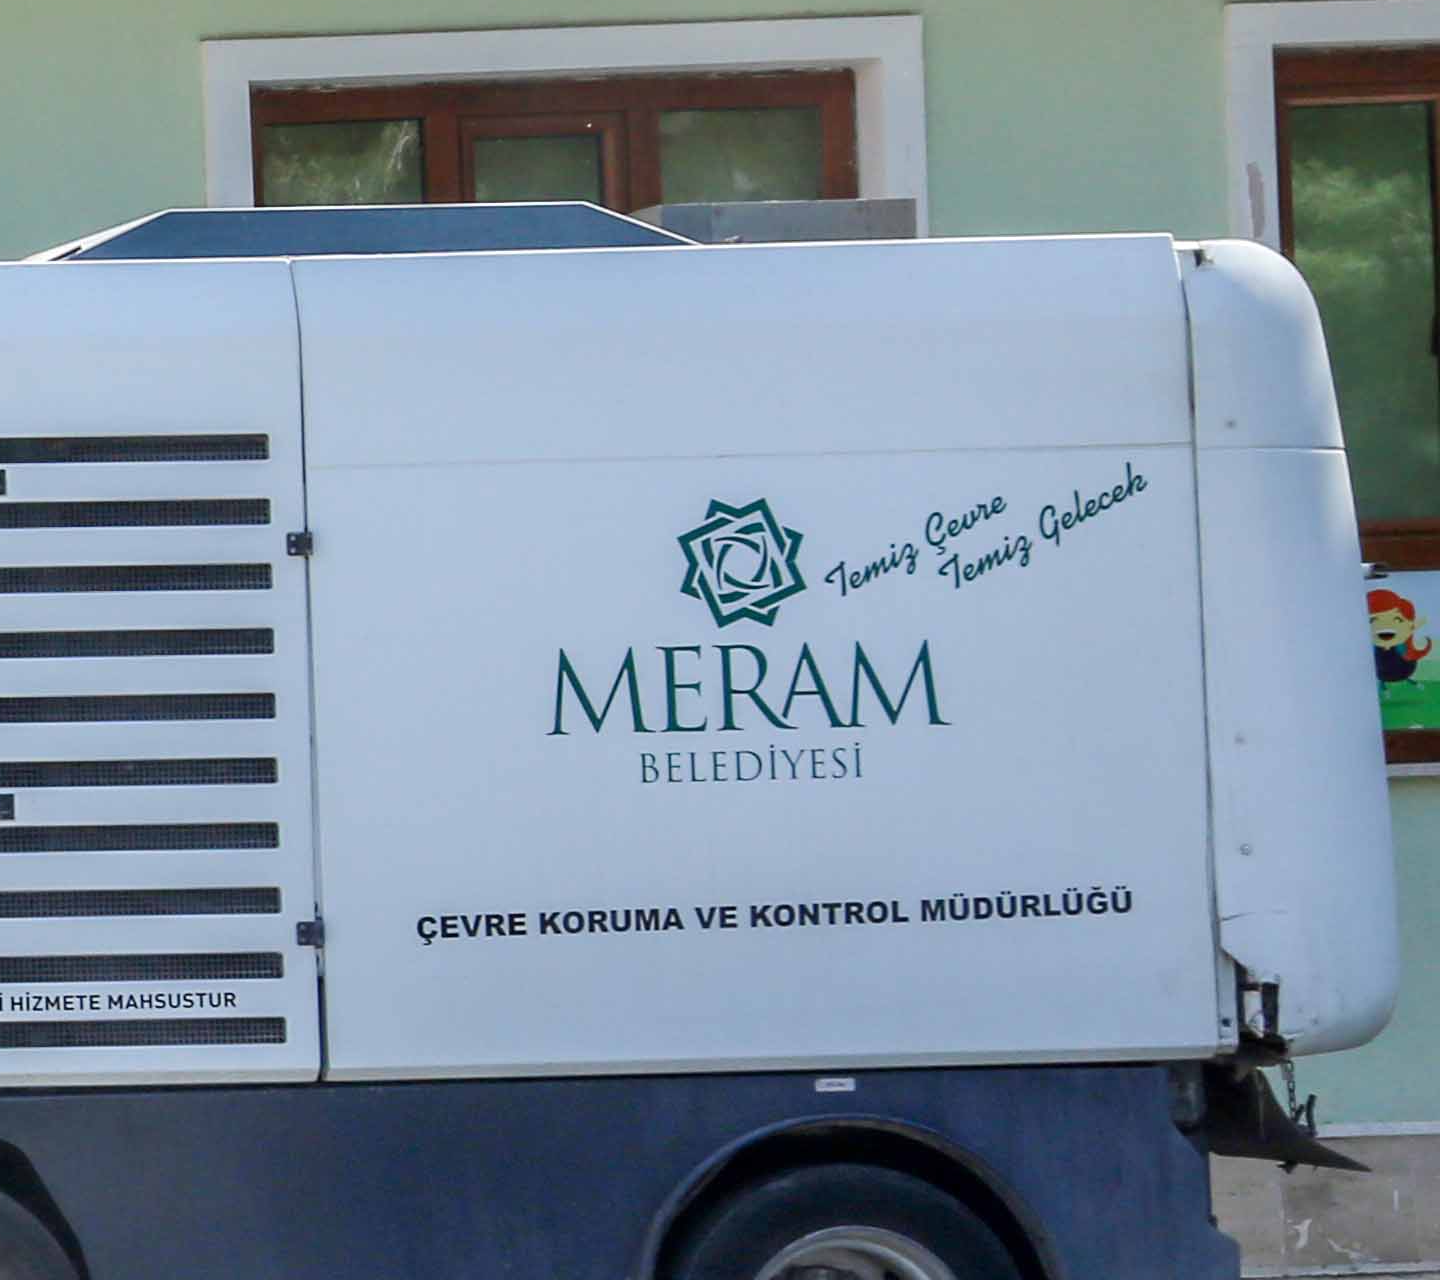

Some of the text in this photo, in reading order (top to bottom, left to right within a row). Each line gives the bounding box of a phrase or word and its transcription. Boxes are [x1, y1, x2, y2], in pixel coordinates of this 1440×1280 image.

[824, 496, 1008, 597] Temiz Çevre
[938, 462, 1148, 589] Temiz Gelecek
[546, 639, 953, 735] MERAM
[640, 742, 864, 783] BELEDİYESİ
[417, 886, 1133, 946] ÇEVRE KORUMA VE KONTROL MÜDÜRLÜĞÜ
[10, 991, 101, 1011] HİZMETE
[108, 992, 237, 1010] MAHSUSTUR
